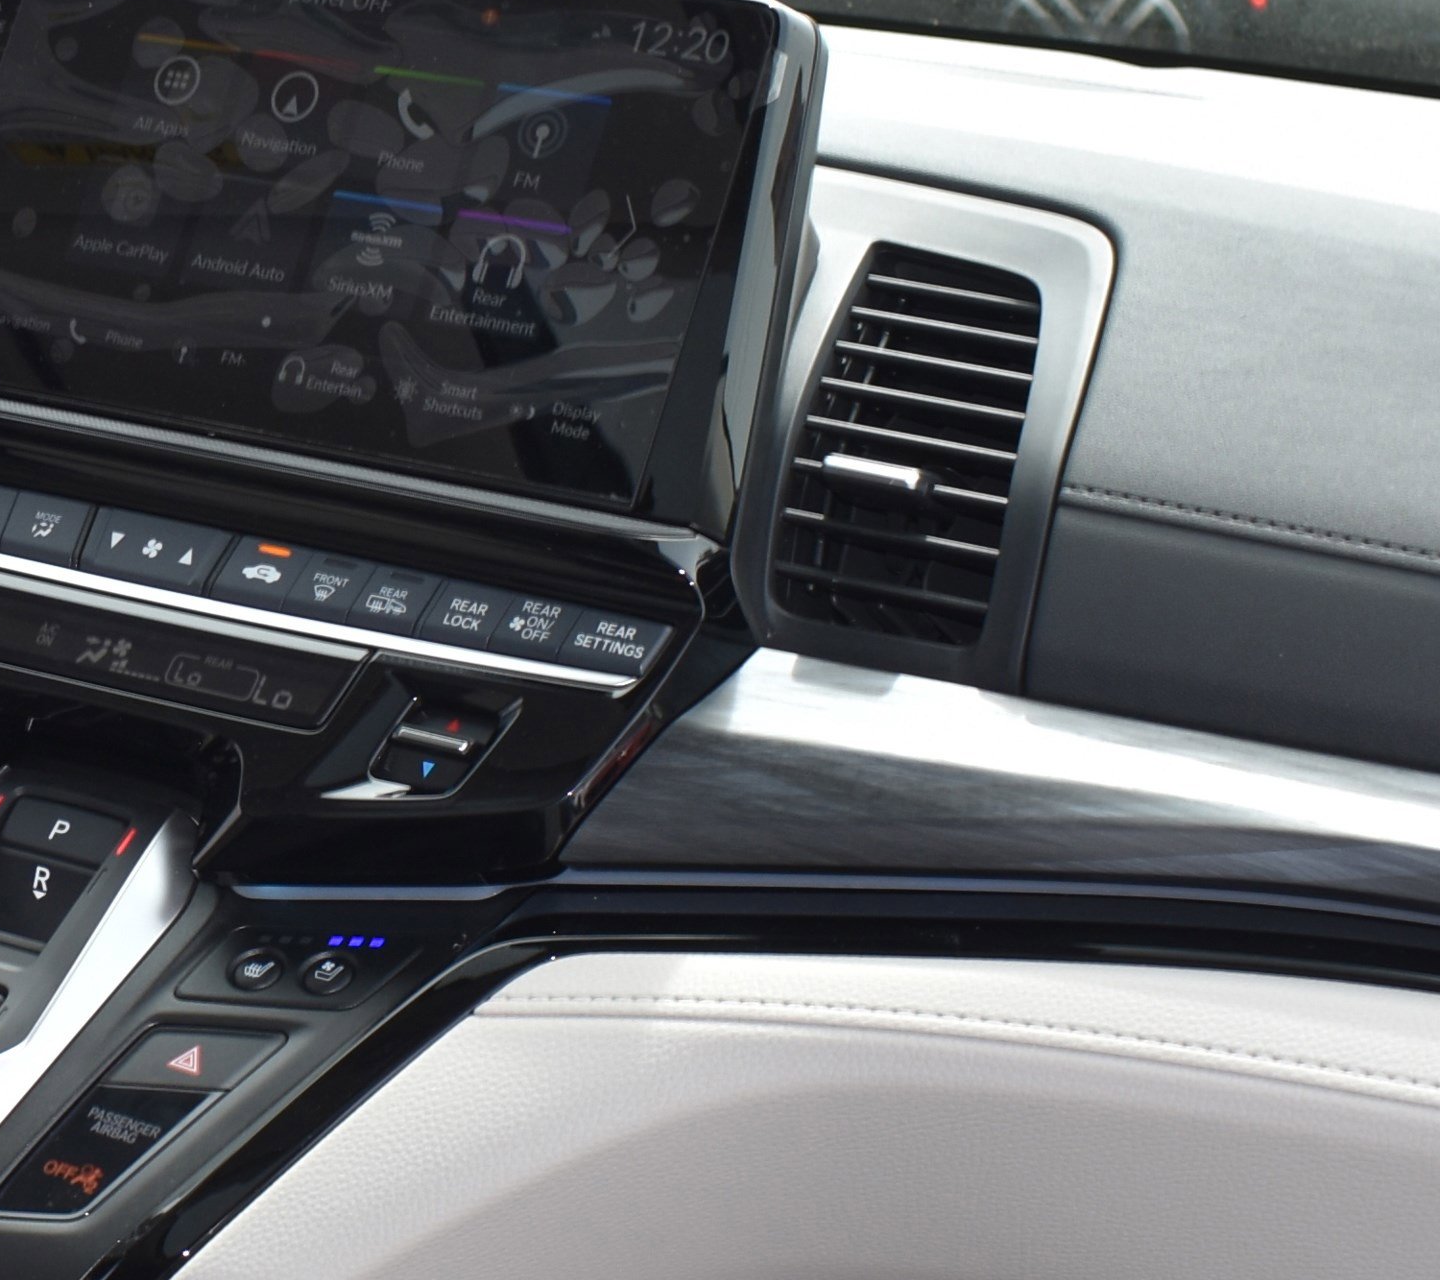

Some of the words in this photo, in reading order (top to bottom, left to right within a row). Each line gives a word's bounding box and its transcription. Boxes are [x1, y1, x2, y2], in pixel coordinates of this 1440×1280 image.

[631, 20, 730, 64] 12:20
[133, 116, 152, 131] All
[155, 120, 190, 138] Apps
[241, 130, 317, 157] Navigation
[377, 151, 425, 172] Phone
[514, 171, 540, 191] FM
[73, 233, 113, 257] Apple
[118, 240, 170, 265] CarPlay
[191, 253, 246, 276] Android
[248, 261, 285, 283] Auto
[329, 277, 393, 301] SiriusXM
[472, 289, 507, 308] Rear
[430, 306, 537, 336] Entertainment
[105, 329, 144, 349] Phone
[331, 361, 359, 379] Rear
[440, 382, 478, 401] Smart
[423, 397, 483, 421] Shortcuts
[552, 401, 602, 423] Display
[550, 421, 591, 439] Mode
[34, 510, 62, 524] MODE
[312, 572, 349, 588] FRONT
[379, 585, 409, 600] REAR
[449, 598, 489, 617] REAR
[521, 600, 562, 619] REAR
[442, 613, 482, 632] LOCK
[526, 616, 556, 632] ON/
[596, 621, 637, 640] REAR
[520, 628, 552, 644] OFF
[573, 633, 645, 660] SETTINGS
[204, 655, 234, 670] REAR
[48, 819, 71, 840] P
[32, 866, 51, 893] R
[87, 1106, 161, 1139] PASSENGER
[89, 1120, 138, 1145] AIRBAG
[43, 1160, 78, 1180] OFF
